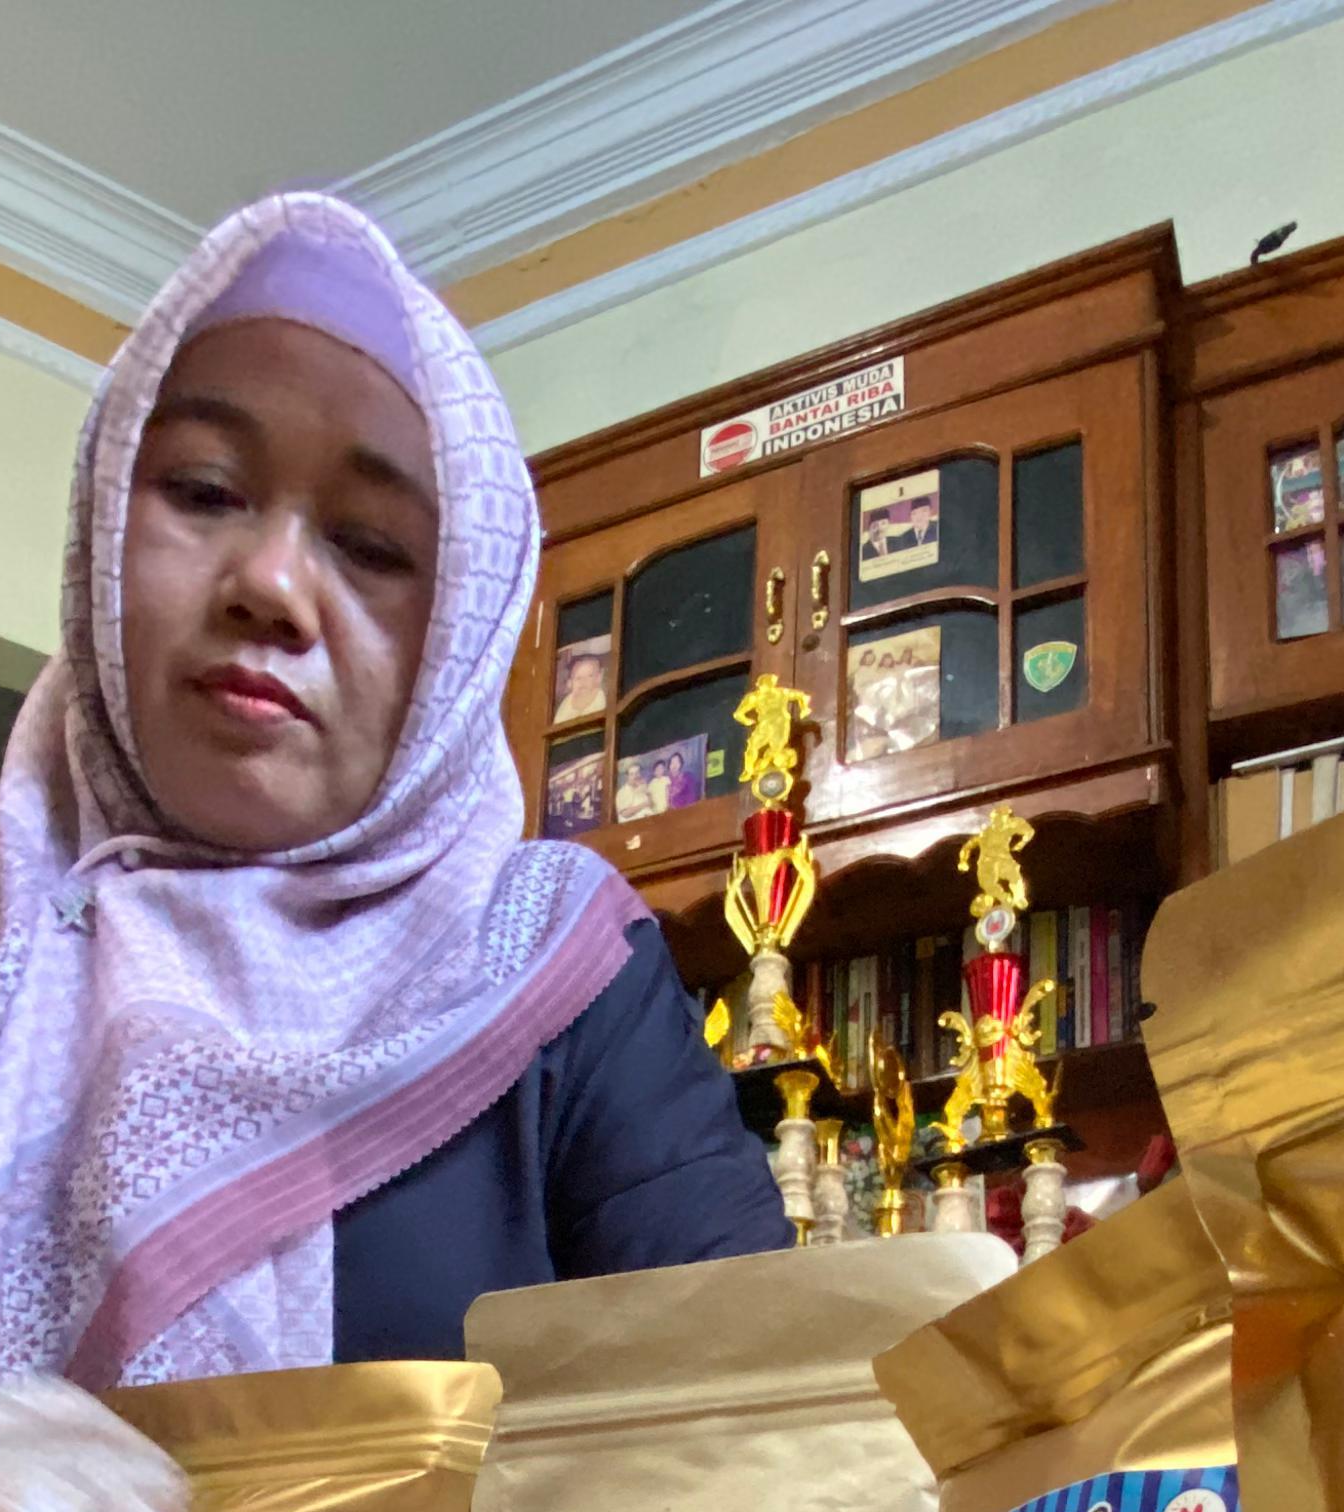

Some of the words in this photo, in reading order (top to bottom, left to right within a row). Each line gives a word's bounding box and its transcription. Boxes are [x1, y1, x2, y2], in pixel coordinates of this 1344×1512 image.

[770, 403, 839, 435] BANTAI
[848, 382, 894, 405] RIBA
[771, 386, 838, 419] AKTIVIS
[844, 366, 892, 393] MUDA
[766, 397, 898, 455] INDONESIA
